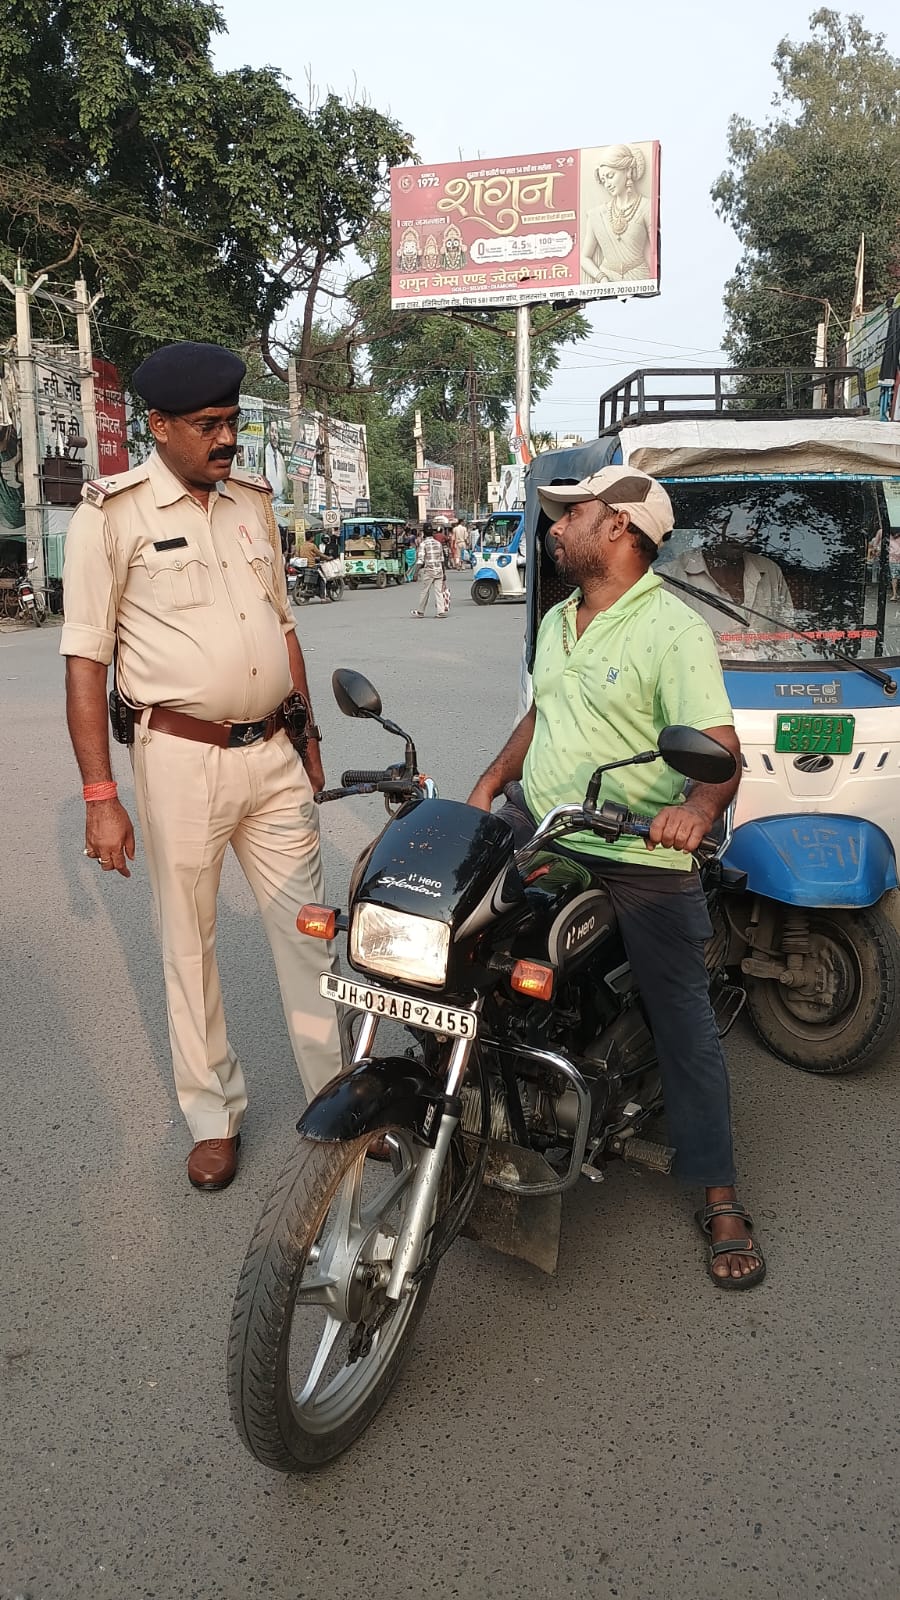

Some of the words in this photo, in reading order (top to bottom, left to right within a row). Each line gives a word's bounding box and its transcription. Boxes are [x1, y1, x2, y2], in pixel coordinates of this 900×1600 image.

[417, 177, 440, 188] 1972
[437, 171, 566, 235] शगुन
[398, 276, 429, 293] शगुन
[432, 272, 460, 288] जेम्स
[462, 272, 488, 285] एण्ड
[813, 696, 838, 704] PLUS
